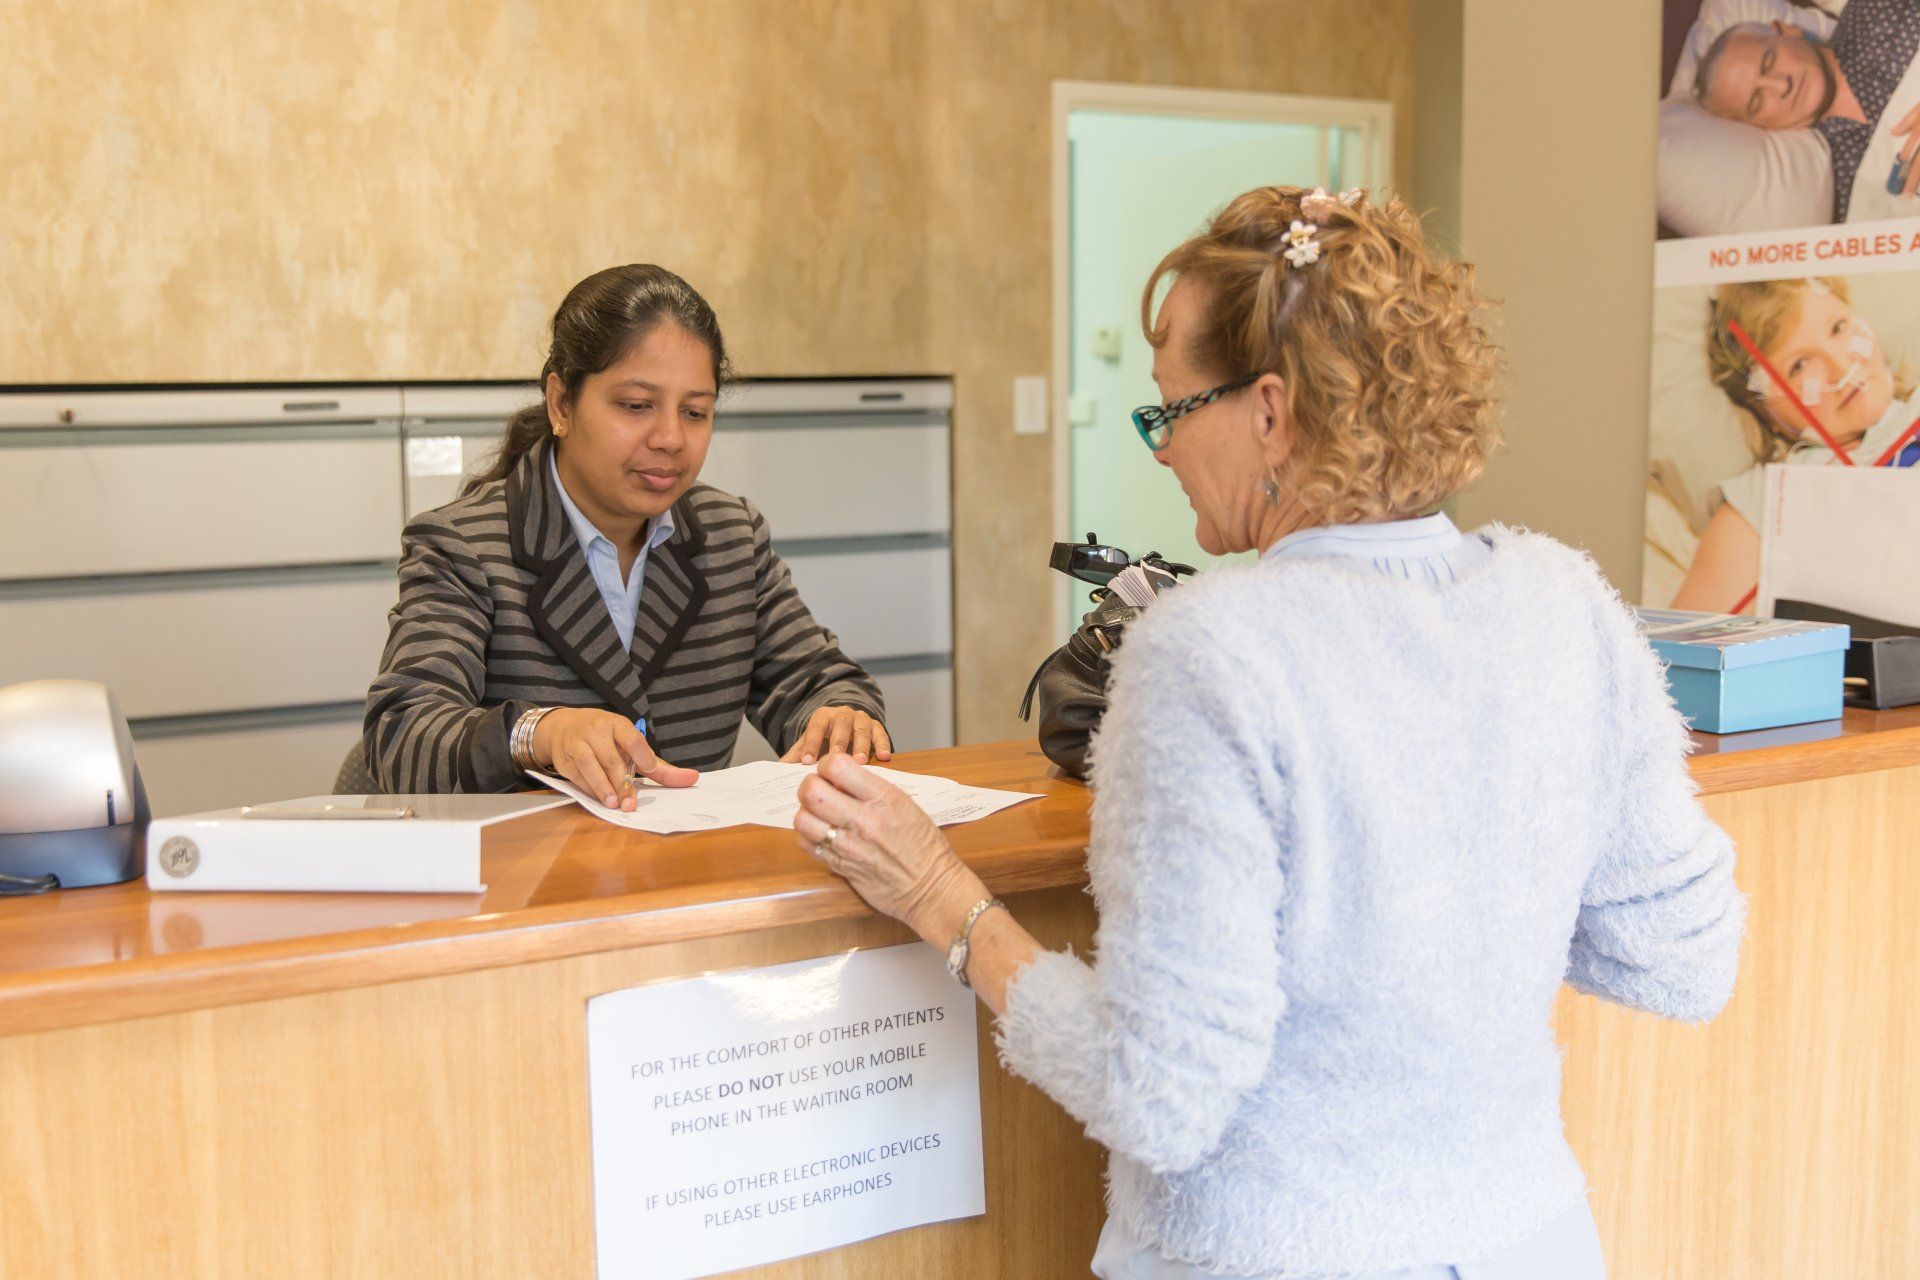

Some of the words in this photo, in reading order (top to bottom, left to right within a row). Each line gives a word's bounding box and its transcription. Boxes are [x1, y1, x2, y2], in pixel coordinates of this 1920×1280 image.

[1710, 248, 1740, 268] NO
[1747, 242, 1807, 265] MORE
[1815, 233, 1901, 259] CABLES
[631, 1059, 664, 1080] FOR
[669, 1052, 701, 1073] THE
[706, 1037, 789, 1066] COMFORT
[794, 1032, 815, 1049] OF
[819, 1020, 871, 1045] OTHER
[875, 1006, 945, 1034] PATIENTS
[654, 1085, 713, 1110] PLEASE
[718, 1080, 743, 1098] DO
[749, 1073, 784, 1092] NOT
[789, 1068, 818, 1085] USE
[823, 1058, 866, 1077] YOUR
[870, 1042, 926, 1070] MOBILE
[671, 1112, 730, 1136] PHONE
[735, 1108, 752, 1124] IN
[757, 1102, 788, 1120] THE
[793, 1085, 862, 1113] WAITING
[866, 1073, 913, 1097] ROOM
[645, 1195, 661, 1211] IF
[665, 1184, 719, 1207] USING
[723, 1171, 779, 1196] OTHER
[783, 1148, 876, 1183] ELECTRONIC
[880, 1133, 941, 1161] DEVICES
[704, 1204, 763, 1228] PLEASE
[767, 1197, 798, 1216] USE
[802, 1172, 892, 1207] EARPHONES
